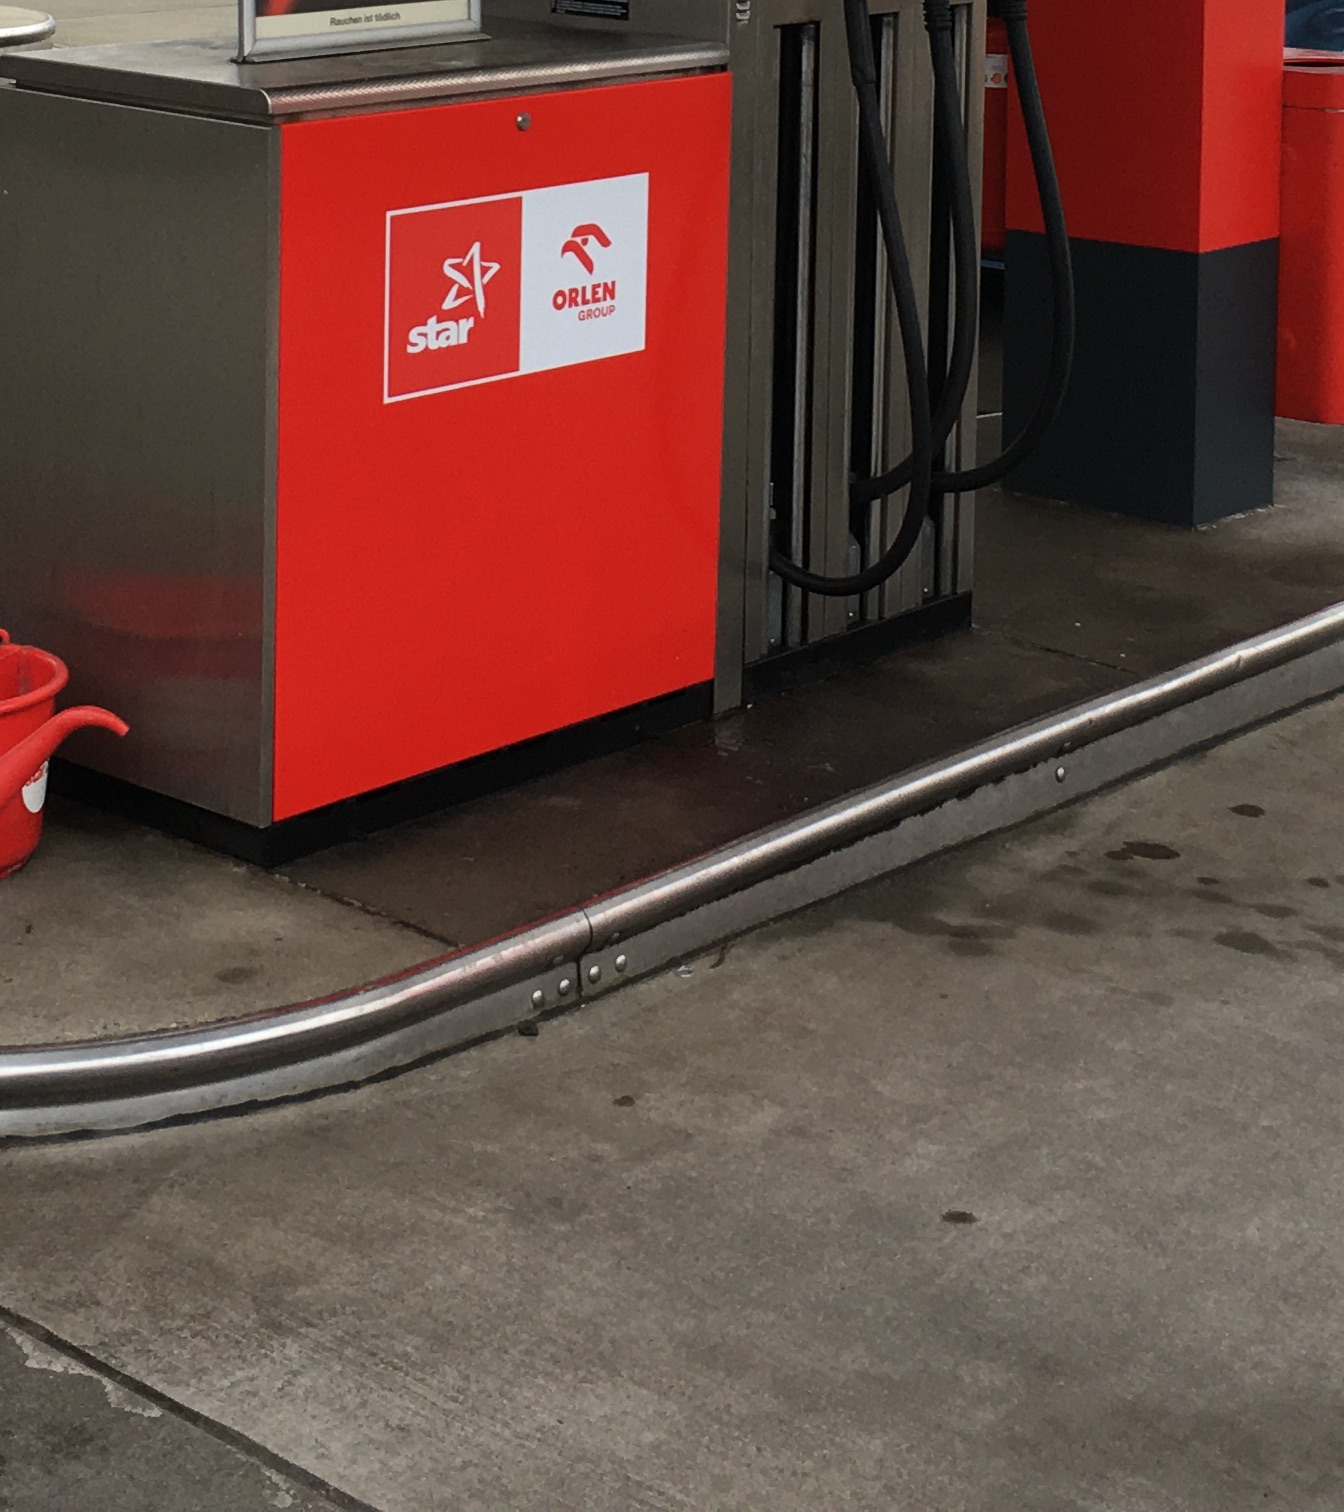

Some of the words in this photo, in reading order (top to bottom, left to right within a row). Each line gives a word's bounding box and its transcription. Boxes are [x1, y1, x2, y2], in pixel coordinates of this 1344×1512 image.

[330, 14, 362, 26] Rauchen
[364, 14, 373, 23] ist
[375, 11, 401, 22] tödlich
[552, 281, 616, 311] ORLEN
[578, 305, 616, 321] GROUP
[407, 315, 474, 353] star
